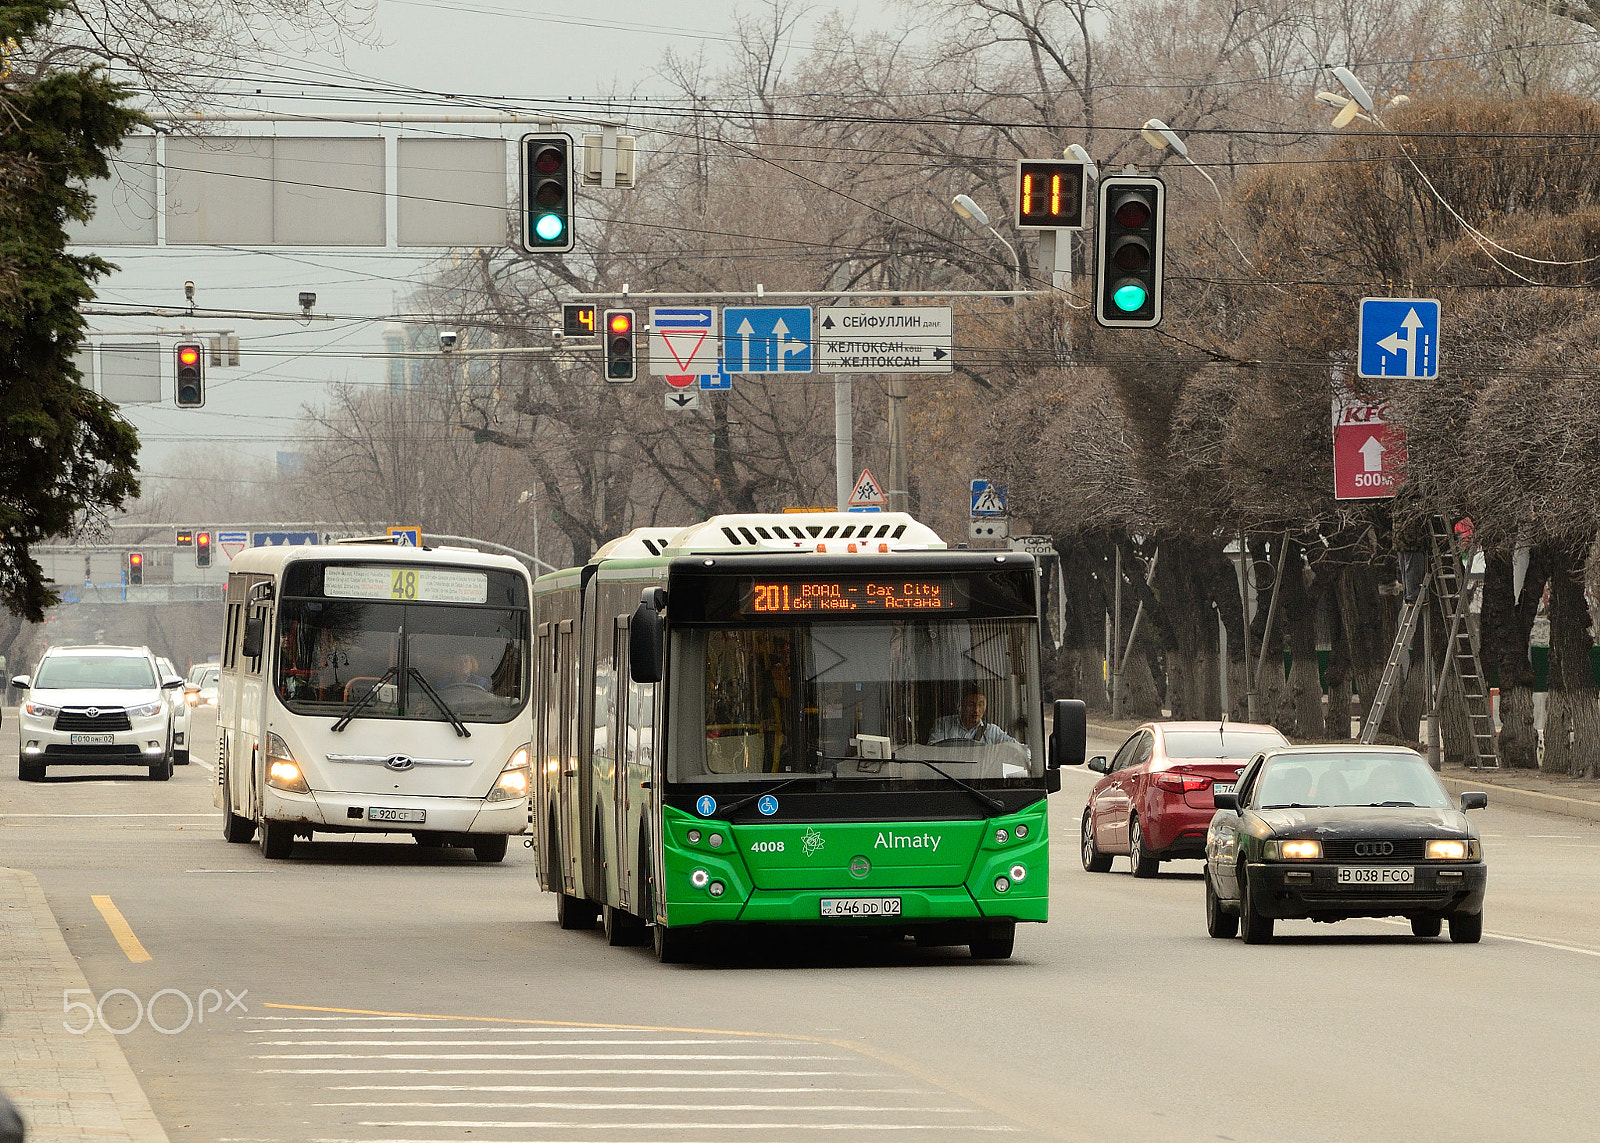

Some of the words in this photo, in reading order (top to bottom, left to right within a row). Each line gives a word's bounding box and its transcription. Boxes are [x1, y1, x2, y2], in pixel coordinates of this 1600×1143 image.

[1023, 173, 1060, 216] 11
[578, 310, 594, 331] 4
[842, 313, 921, 328] СЕЙФУЛЛИН
[827, 341, 903, 354] ЖЕЛТОҚСАН
[840, 356, 921, 368] ЖЕЛТОКСАН
[392, 570, 416, 600] 48
[802, 584, 841, 598] ВОАД
[866, 583, 895, 596] Car
[903, 583, 940, 596] City
[754, 585, 790, 611] 201
[885, 596, 941, 608] Астана
[380, 810, 397, 819] 920
[751, 841, 785, 852] 4008
[874, 832, 941, 852] Almaty
[1342, 870, 1351, 881] B
[1355, 870, 1378, 882] 038
[836, 901, 859, 913] 646
[863, 903, 878, 913] DD
[883, 900, 899, 913] 02
